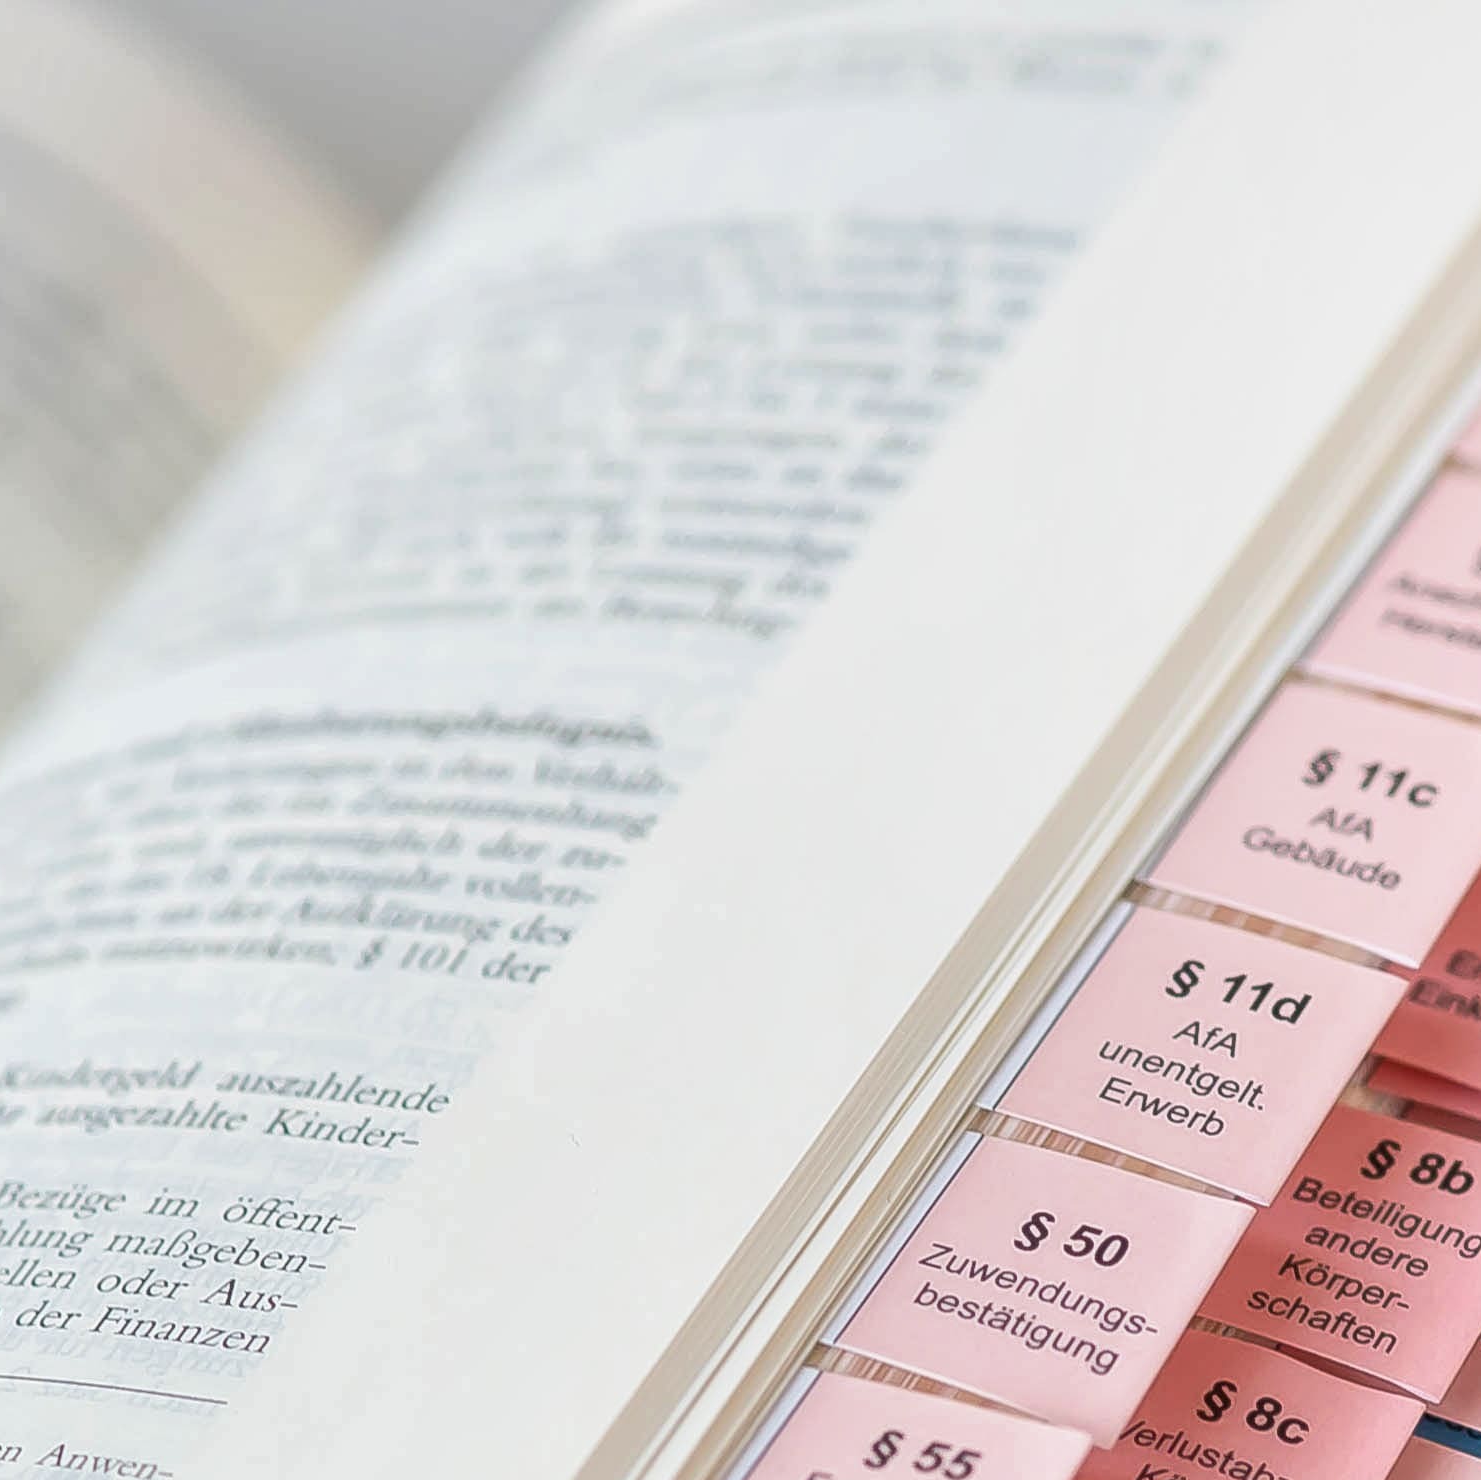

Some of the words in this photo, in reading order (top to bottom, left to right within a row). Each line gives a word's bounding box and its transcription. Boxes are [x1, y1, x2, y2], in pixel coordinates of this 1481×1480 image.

[1301, 748, 1341, 789] §
[1358, 762, 1438, 809] 11c
[1311, 806, 1374, 841] AfA
[1242, 825, 1402, 890] Gebäude
[399, 938, 466, 975] 101
[482, 952, 551, 985] der
[1165, 959, 1205, 1000] §
[1222, 972, 1313, 1025] 11d
[1172, 1021, 1238, 1059] AfA
[216, 1071, 450, 1115] auszahlende
[1098, 1039, 1266, 1111] unentgelt.
[263, 1106, 420, 1150] Kinder-
[1098, 1077, 1227, 1139] Erwerb
[1360, 1139, 1401, 1181] §
[1409, 1151, 1475, 1196] 8b
[144, 1187, 200, 1218] im
[222, 1196, 357, 1235] öffent-
[1014, 1211, 1056, 1254] §
[1063, 1224, 1129, 1268] 50
[103, 1229, 327, 1275] maßgeben-
[1304, 1224, 1430, 1280] andere
[95, 1268, 189, 1301] oder
[200, 1279, 298, 1313] Aus-
[918, 1244, 1159, 1338] Zuwendungs-
[1278, 1255, 1410, 1314] Körper-
[16, 1301, 82, 1333] der
[90, 1306, 272, 1355] Finanzen
[914, 1281, 1120, 1376] bestätigung
[1247, 1289, 1398, 1355] schaften
[1196, 1380, 1238, 1423] §
[1246, 1396, 1310, 1445] 8c
[864, 1430, 904, 1470] §
